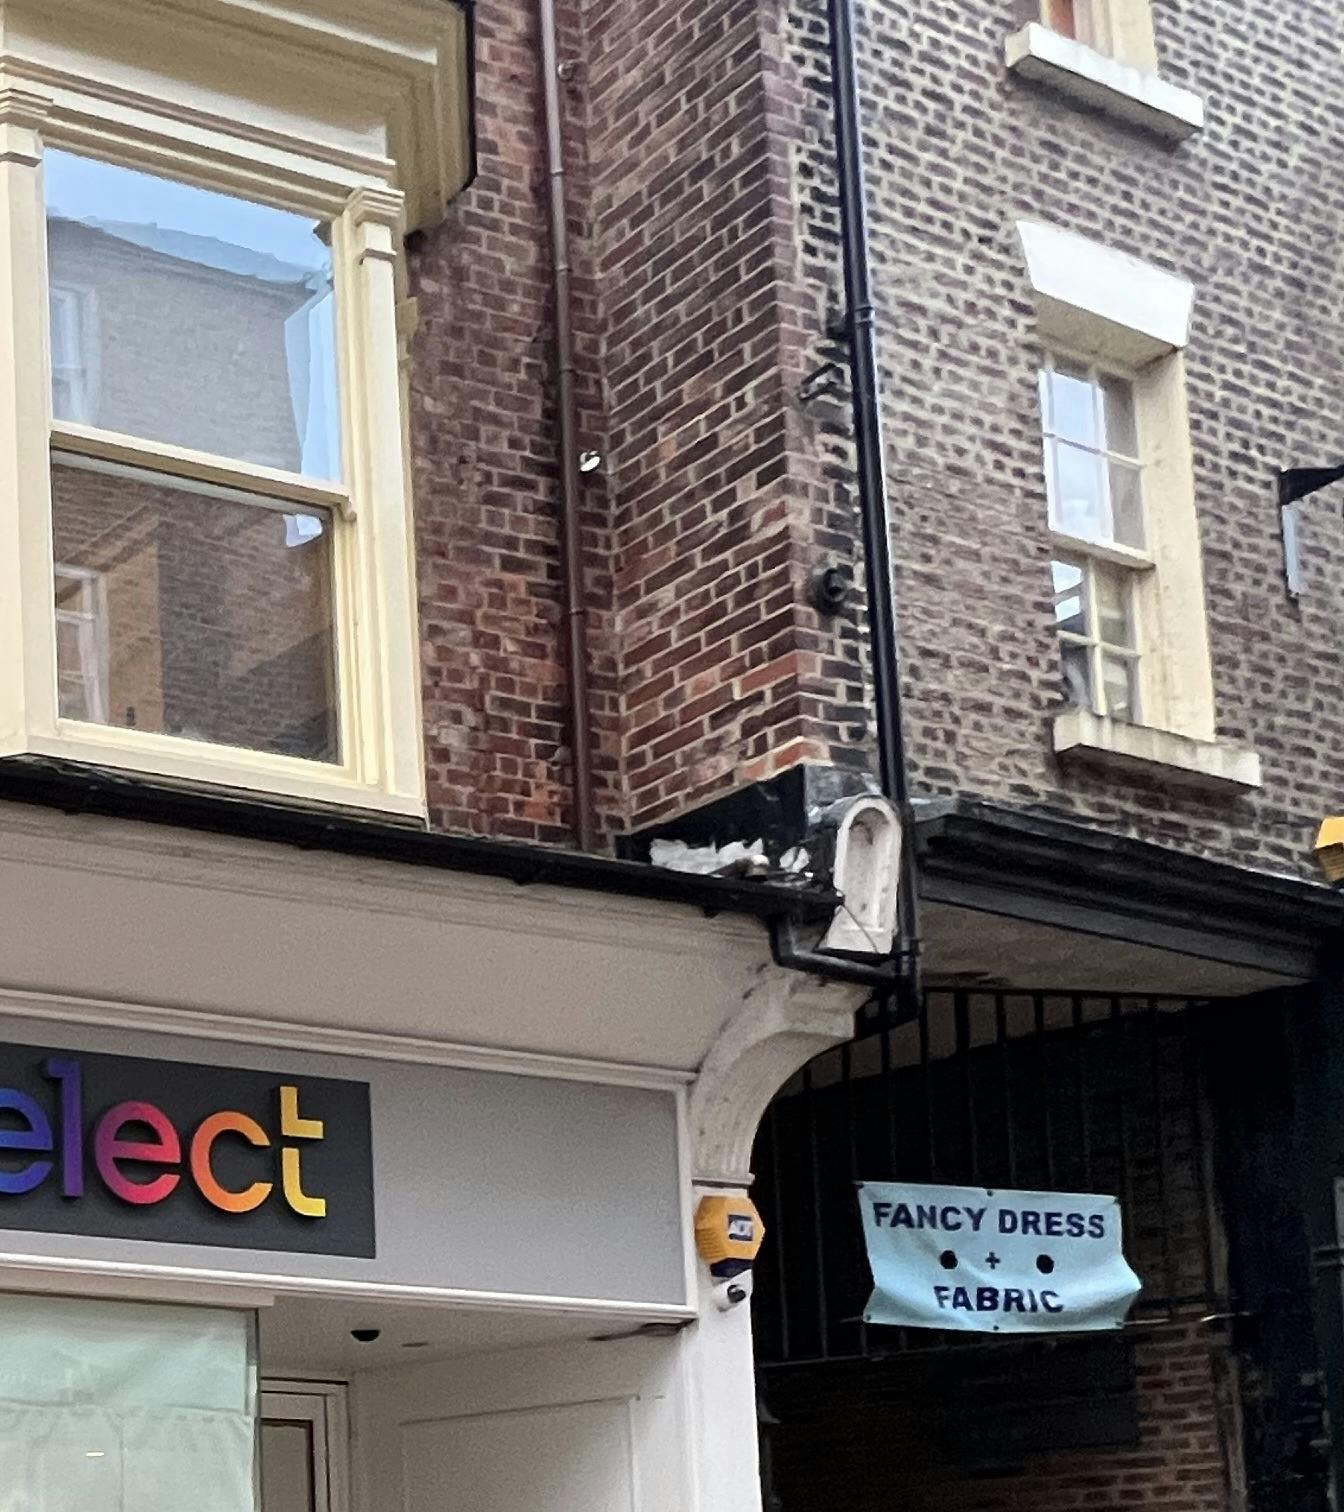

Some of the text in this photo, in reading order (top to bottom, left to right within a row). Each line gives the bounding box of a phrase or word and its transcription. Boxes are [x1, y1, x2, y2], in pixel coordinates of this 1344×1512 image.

[872, 1202, 1106, 1239] FANCY DRESS
[933, 1285, 1065, 1314] FABRIC
